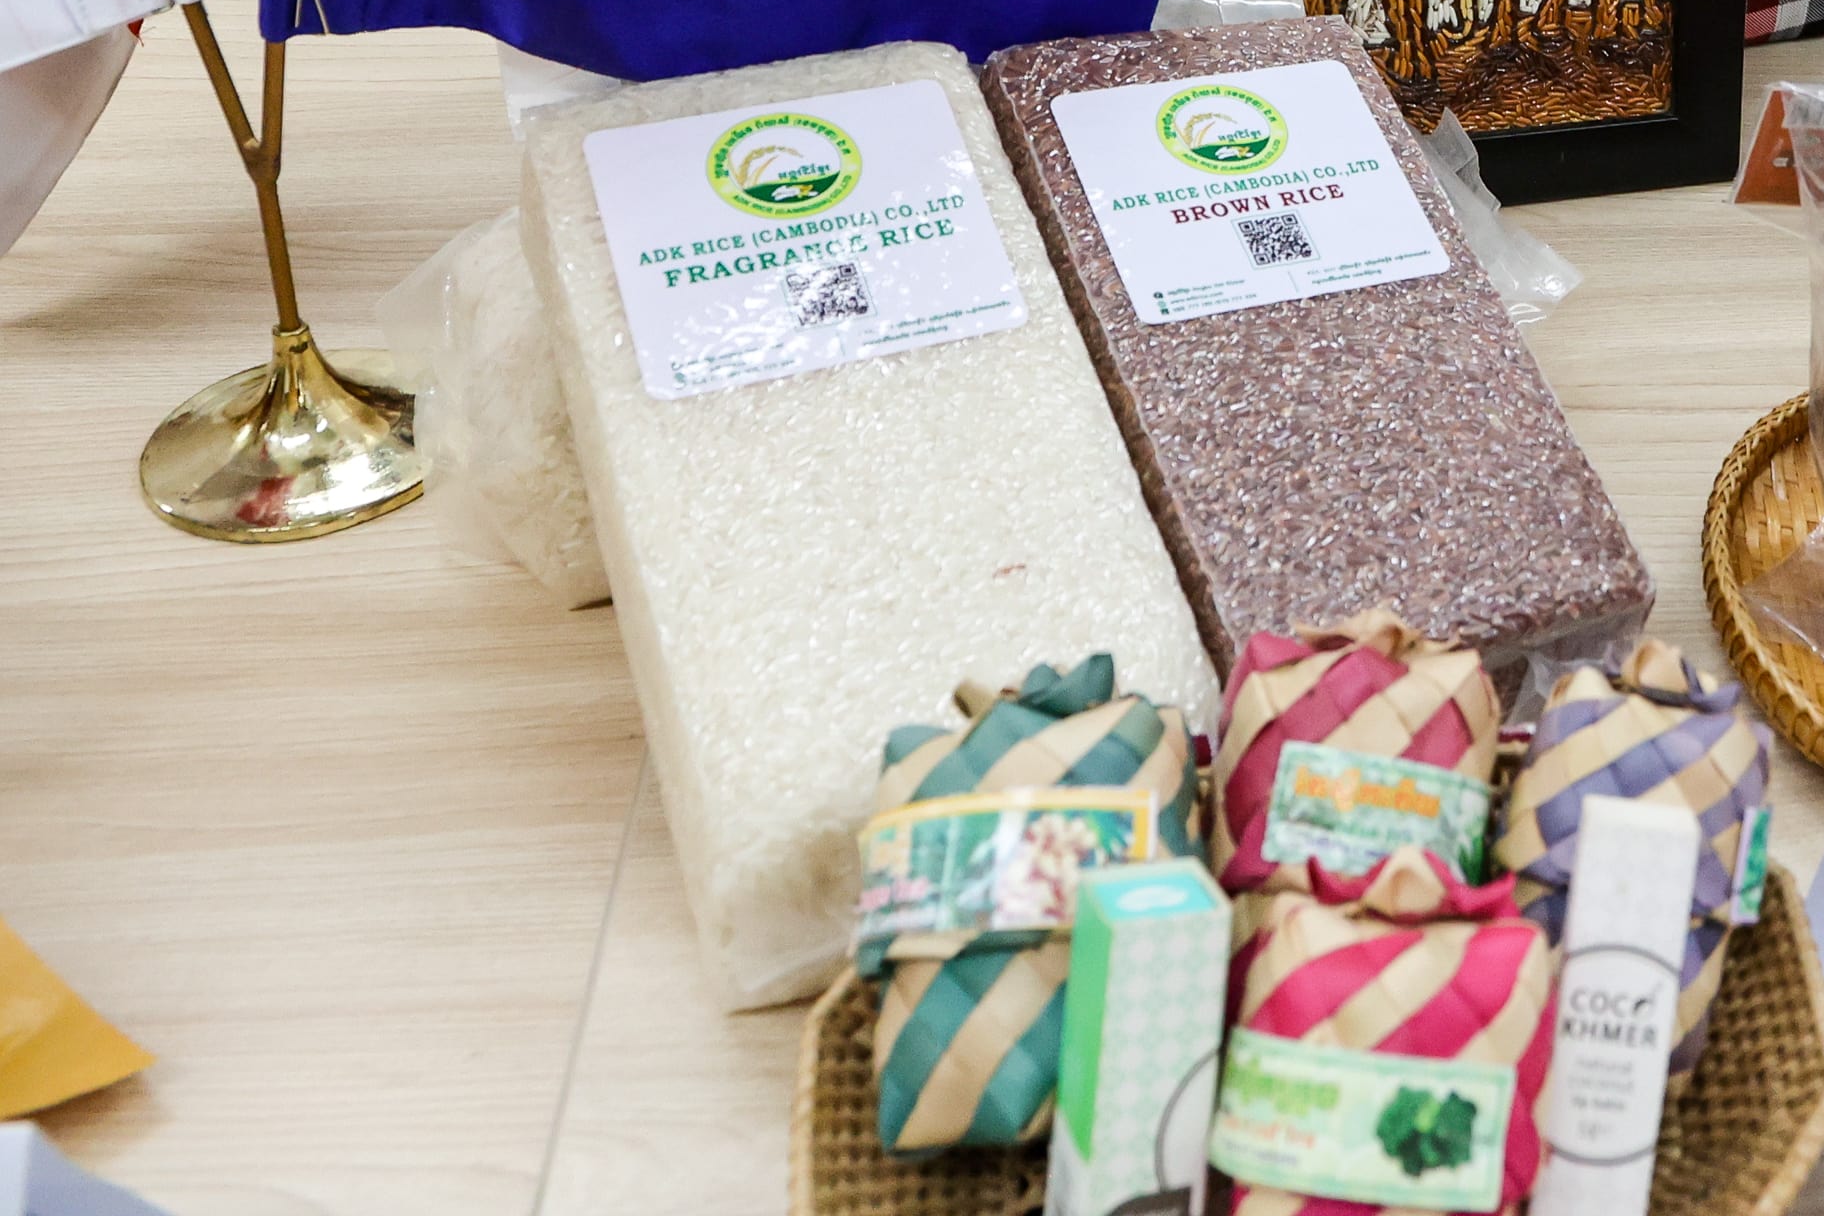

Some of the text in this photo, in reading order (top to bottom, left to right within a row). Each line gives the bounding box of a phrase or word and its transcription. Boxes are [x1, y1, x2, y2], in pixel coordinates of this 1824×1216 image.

[1112, 195, 1151, 212] ADK
[1155, 185, 1200, 204] RICE
[1204, 169, 1310, 201] (CAMBODIA)
[1171, 183, 1345, 225] BROWN RICE
[639, 245, 684, 267] ADK
[692, 234, 746, 257] RICE
[751, 209, 879, 248] (CAMBODIA)
[664, 218, 956, 289] FRAGRANCE RICE
[1562, 1019, 1659, 1048] KHMER
